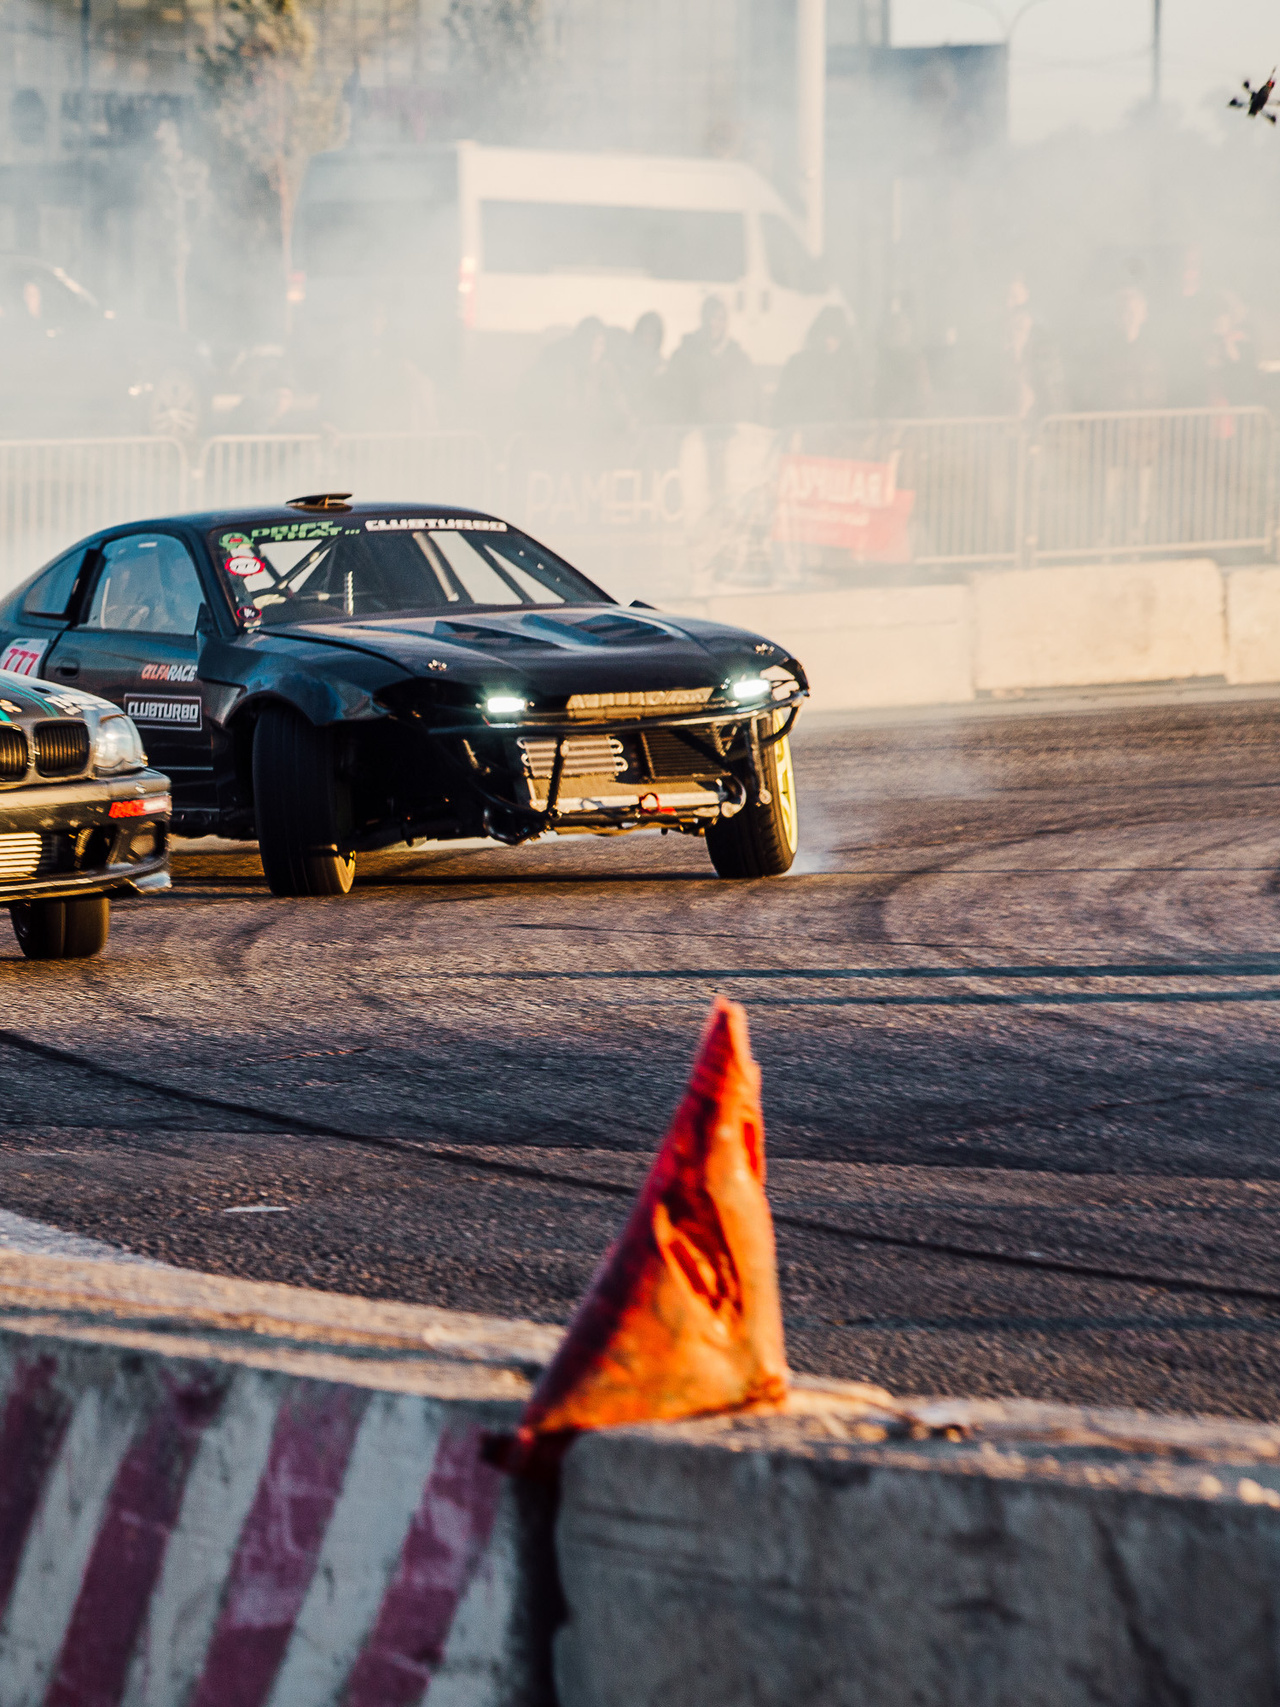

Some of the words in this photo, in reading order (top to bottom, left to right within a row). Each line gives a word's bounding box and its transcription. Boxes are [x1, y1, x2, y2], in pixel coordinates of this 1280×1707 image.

[251, 520, 334, 537] DRIFT
[3, 648, 40, 676] 777
[127, 701, 199, 723] CLUBTURBO
